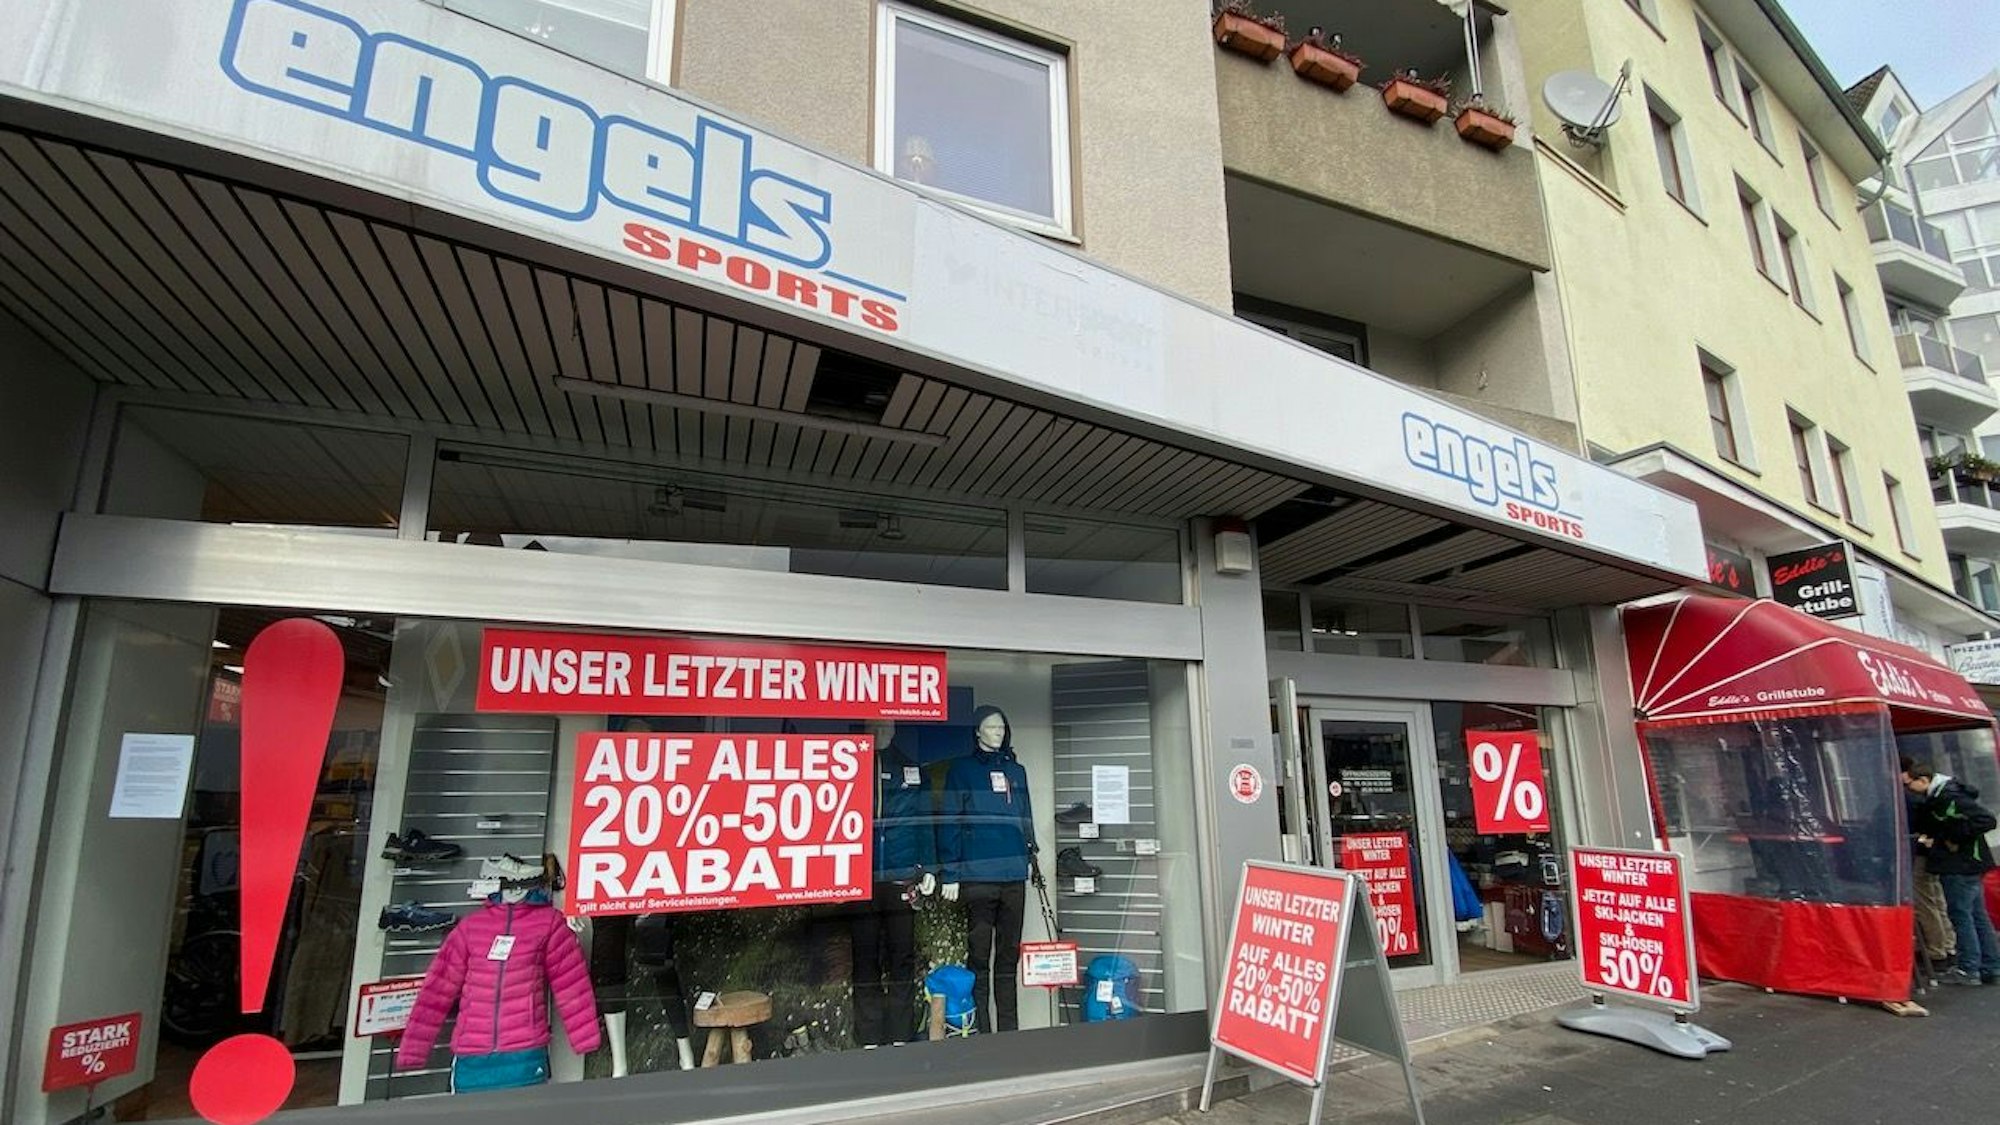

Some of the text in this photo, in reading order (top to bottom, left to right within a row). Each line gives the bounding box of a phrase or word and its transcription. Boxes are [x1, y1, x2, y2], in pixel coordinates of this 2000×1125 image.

[220, 0, 832, 270] engels
[623, 222, 899, 332] SPORTS
[1402, 412, 1559, 512] engels
[1506, 502, 1583, 539] SPORTS
[1798, 579, 1850, 599] Grill-
[490, 646, 941, 704] UNSER LETZTER WINTER
[1757, 687, 1825, 702] Grillstube
[583, 738, 693, 783] AUF
[1472, 741, 1544, 821] %
[580, 782, 864, 848] 20%-50%
[1346, 836, 1404, 850] UNSER LETZTER
[1362, 849, 1392, 861] WINTER
[576, 843, 864, 900] RABATT
[1389, 866, 1408, 879] ALLE
[1579, 853, 1673, 874] UNSER LETZTER
[1602, 870, 1648, 886] WINTER
[599, 900, 626, 911] nicht
[629, 899, 646, 910] auf
[648, 895, 739, 910] Serviceleistungen.
[775, 887, 863, 901] www.leicht-co.de
[1245, 886, 1340, 923] UNSER LETZTER
[1582, 888, 1677, 913] JETZT AUF ALLE
[1252, 912, 1316, 947] WINTER
[1595, 905, 1665, 928] SKI-JACKEN
[1624, 923, 1635, 937] &
[1376, 915, 1408, 952] 0%
[1600, 931, 1664, 954] SKI-HOSEN
[1238, 942, 1326, 983] AUF ALLES
[1600, 946, 1673, 998] 50%
[1233, 960, 1321, 1014] 20%-50%
[1229, 988, 1320, 1040] RABATT
[61, 1037, 130, 1060] REDUZIERT!
[62, 1021, 132, 1049] STARK
[81, 1051, 106, 1076] %
